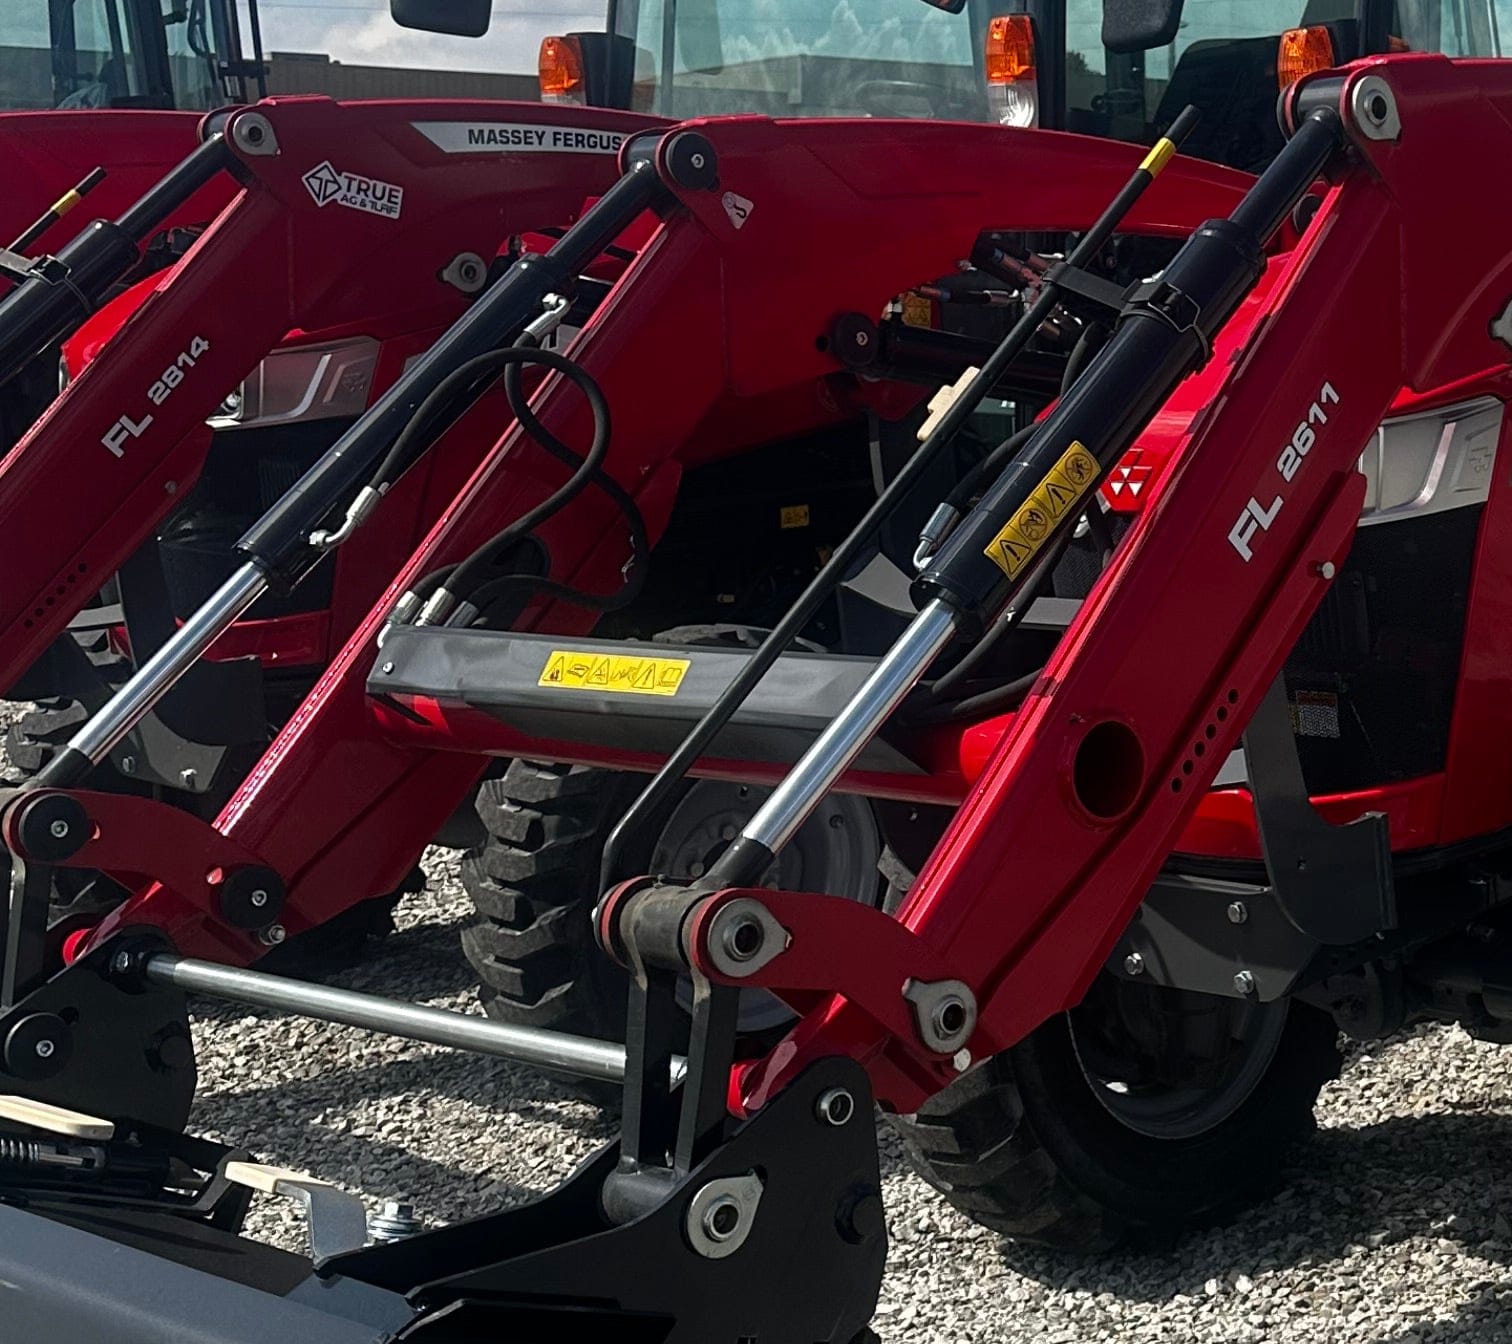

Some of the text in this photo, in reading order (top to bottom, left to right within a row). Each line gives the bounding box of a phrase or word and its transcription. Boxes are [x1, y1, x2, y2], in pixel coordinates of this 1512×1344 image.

[468, 129, 622, 150] MASSEY FERGUS
[340, 194, 357, 205] AG
[360, 198, 367, 208] &
[343, 176, 401, 205] TRUE
[101, 335, 209, 458] FL 2814
[1227, 382, 1340, 563] FL 2611
